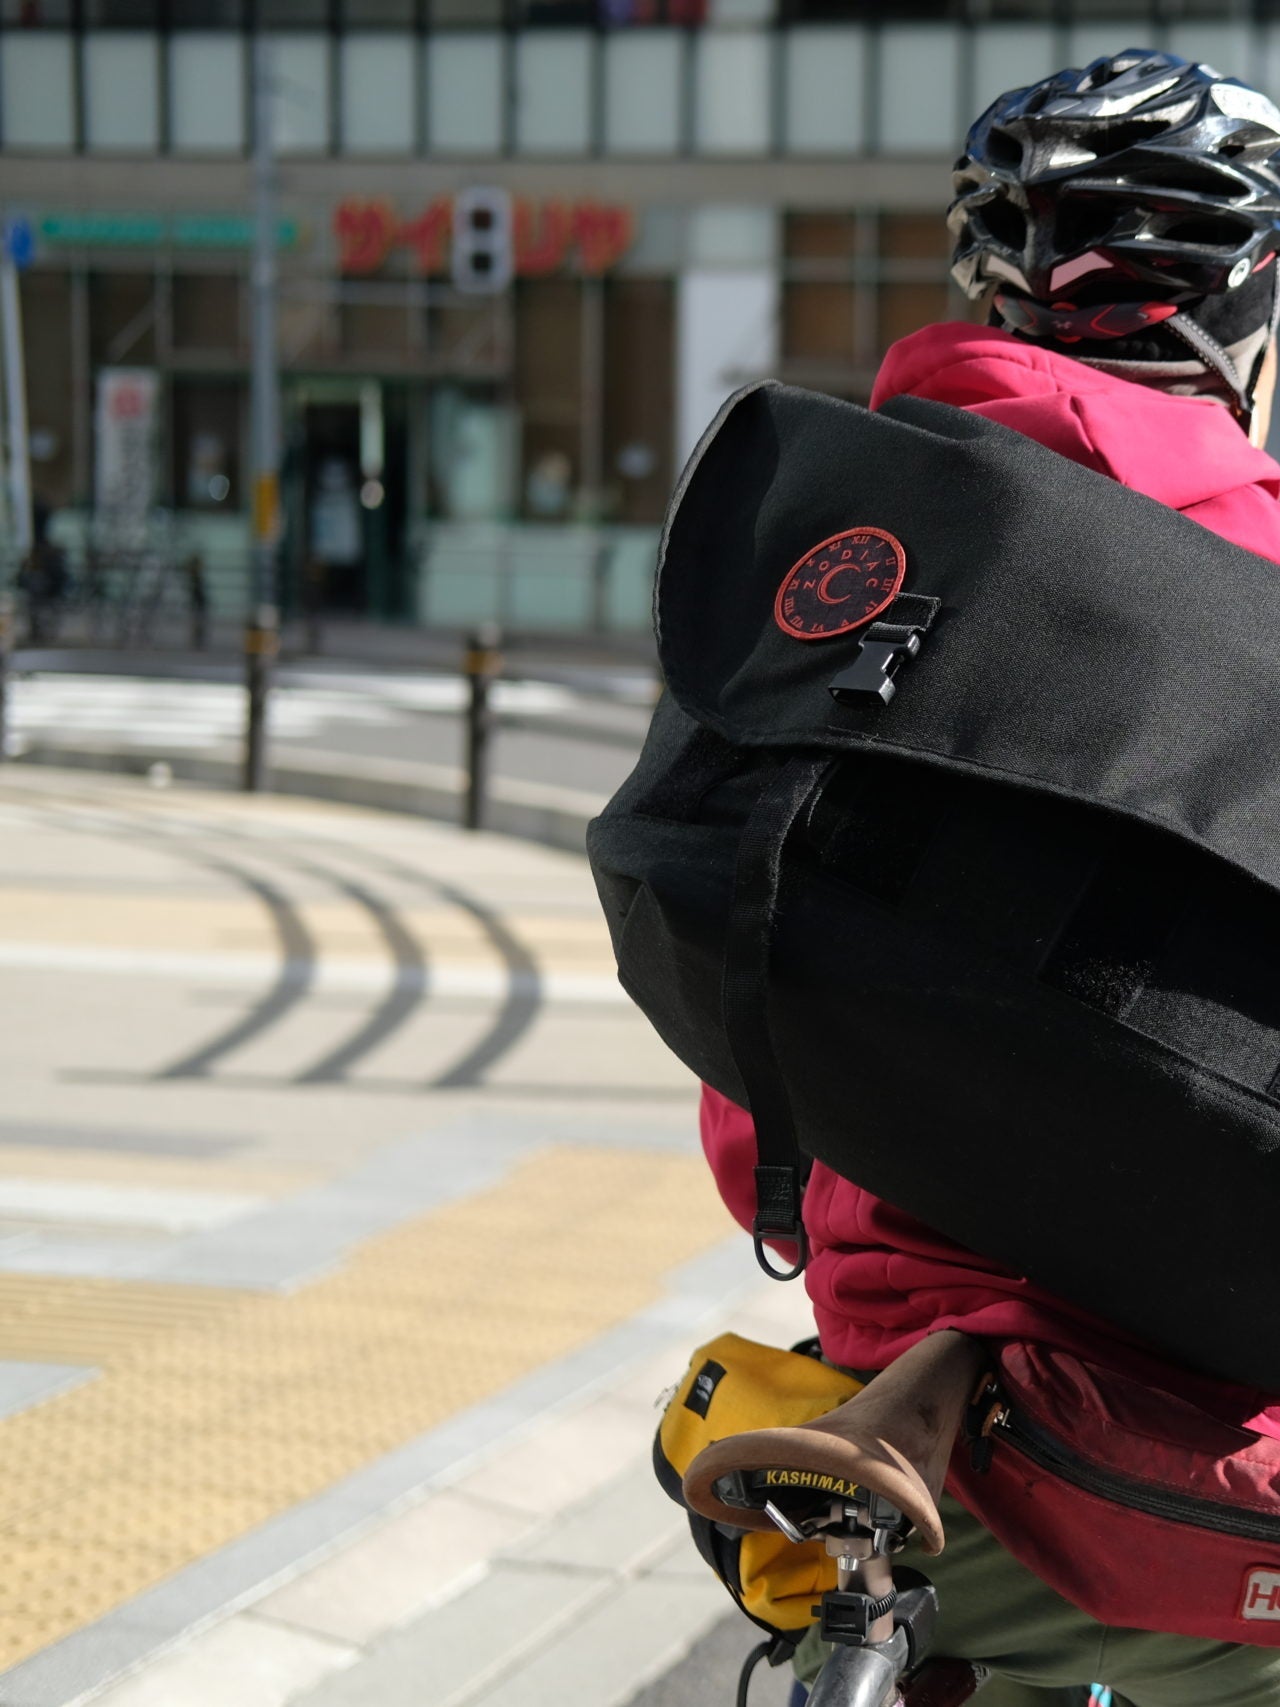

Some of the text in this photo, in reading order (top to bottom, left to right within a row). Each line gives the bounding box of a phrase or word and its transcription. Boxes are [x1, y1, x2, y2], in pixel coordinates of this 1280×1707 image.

[334, 194, 635, 274] サイリヤ
[803, 549, 880, 590] ZODIAC
[766, 1470, 858, 1497] KASHIMAX
